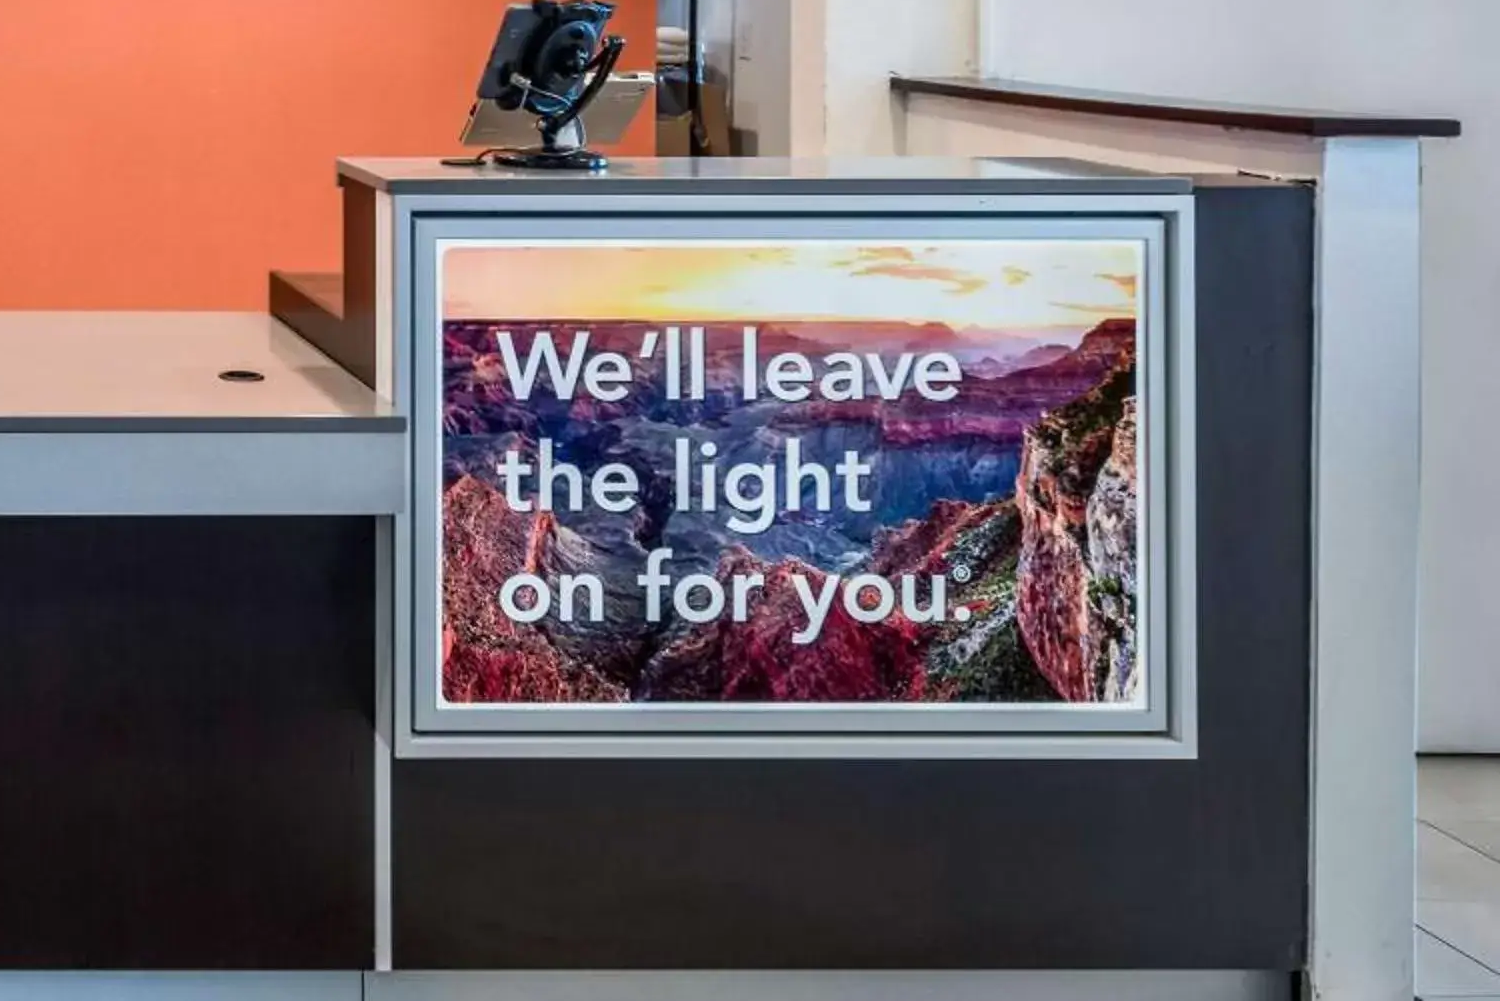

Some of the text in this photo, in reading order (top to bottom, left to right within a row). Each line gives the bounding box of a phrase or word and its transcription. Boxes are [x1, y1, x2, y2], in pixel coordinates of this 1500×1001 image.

[496, 326, 963, 402] We’ll leave
[496, 437, 871, 534] the light
[498, 571, 603, 623] on
[637, 548, 765, 623] for
